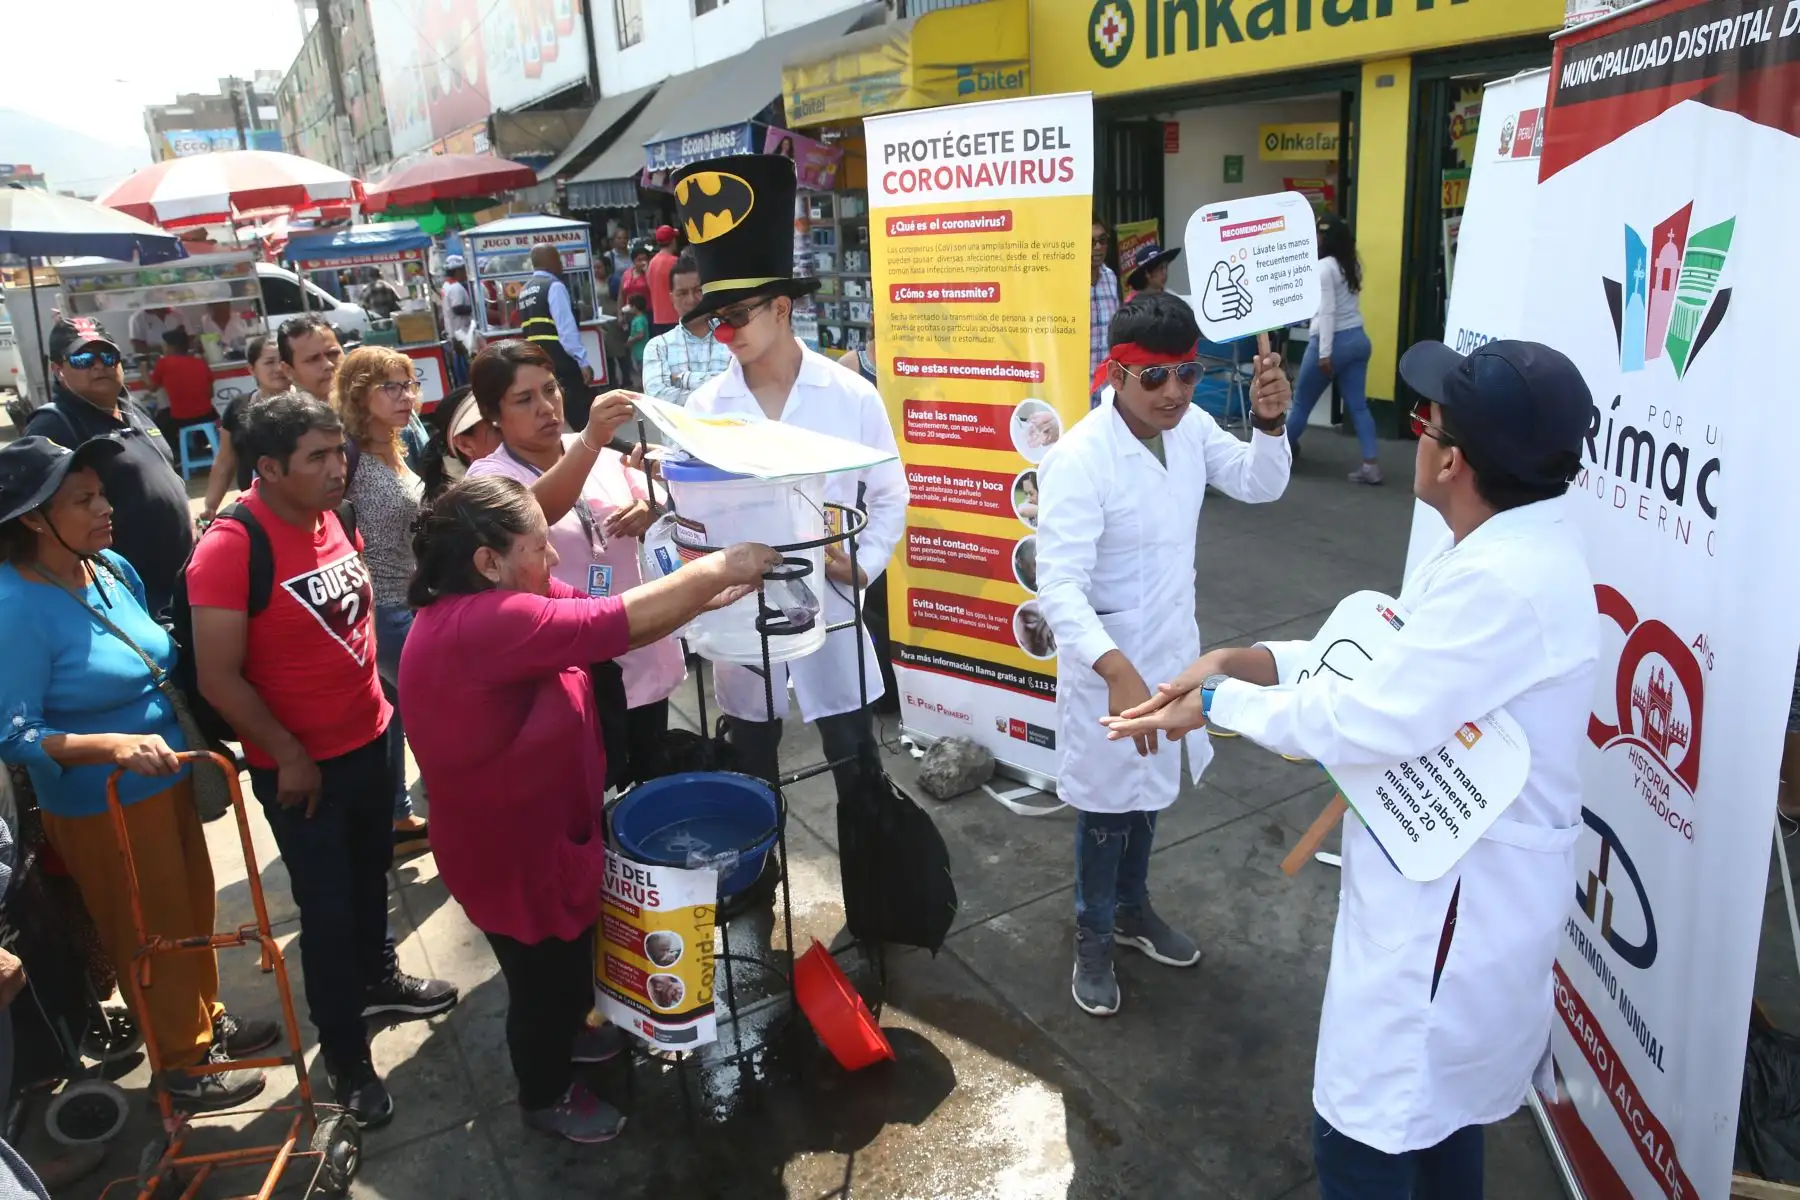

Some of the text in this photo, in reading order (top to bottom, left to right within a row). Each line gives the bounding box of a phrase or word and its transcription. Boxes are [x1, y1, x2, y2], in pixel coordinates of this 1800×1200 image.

[1560, 35, 1673, 89] MUNICIPALIDAD
[1673, 6, 1774, 63] DISTRITAL
[977, 70, 1024, 93] bitel
[1517, 124, 1534, 141] PERÚ
[883, 126, 1071, 165] PROTÉGETE DEL
[882, 156, 1075, 195] CORONAVIRUS
[890, 216, 1006, 235] ¿Qué es el coronavirus?
[1222, 221, 1285, 238] RECOMENDACIONES
[483, 232, 581, 249] JUGO DE NARANJA
[1031, 240, 1041, 248] de
[1042, 240, 1060, 249] virus
[1060, 241, 1076, 250] que
[1253, 239, 1310, 256] Lávate las manos
[1032, 251, 1040, 260] el
[1043, 251, 1076, 260] resfriado
[1256, 252, 1310, 269] frecuentemente
[1256, 264, 1313, 283] con agua y jabón,
[895, 287, 996, 301] ¿Cómo se transmite?
[1269, 278, 1304, 294] mínimo 20
[1272, 293, 1304, 307] segundos
[990, 313, 1000, 321] de
[1036, 314, 1070, 324] persona,
[1034, 325, 1077, 335] expulsadas
[896, 361, 1040, 379] Sigue estas recomendaciones:
[908, 409, 978, 423] Lávate las manos
[1648, 404, 1684, 436] POR
[927, 430, 935, 438] 20
[961, 425, 975, 433] agua
[975, 426, 979, 434] y
[908, 472, 1004, 491] Cúbrete la nariz y boca
[909, 534, 932, 545] Evita
[933, 536, 941, 546] el
[942, 539, 979, 552] contacto
[307, 556, 370, 606] GUESS
[912, 598, 934, 609] Evita
[935, 602, 965, 615] tocarte
[965, 608, 974, 617] los
[900, 649, 1049, 691] Para más información llama gratis al 113
[1437, 746, 1488, 809] las manos
[1628, 746, 1671, 801] HISTORIA
[1417, 754, 1472, 820] entemente
[1384, 769, 1436, 832] mínimo 20
[1399, 761, 1462, 840] agua y jabón,
[1633, 772, 1695, 844] Y TRADICIÓ
[1375, 785, 1421, 843] segundos
[621, 862, 657, 888] DEL
[1619, 988, 1665, 1074] MUNDIAL
